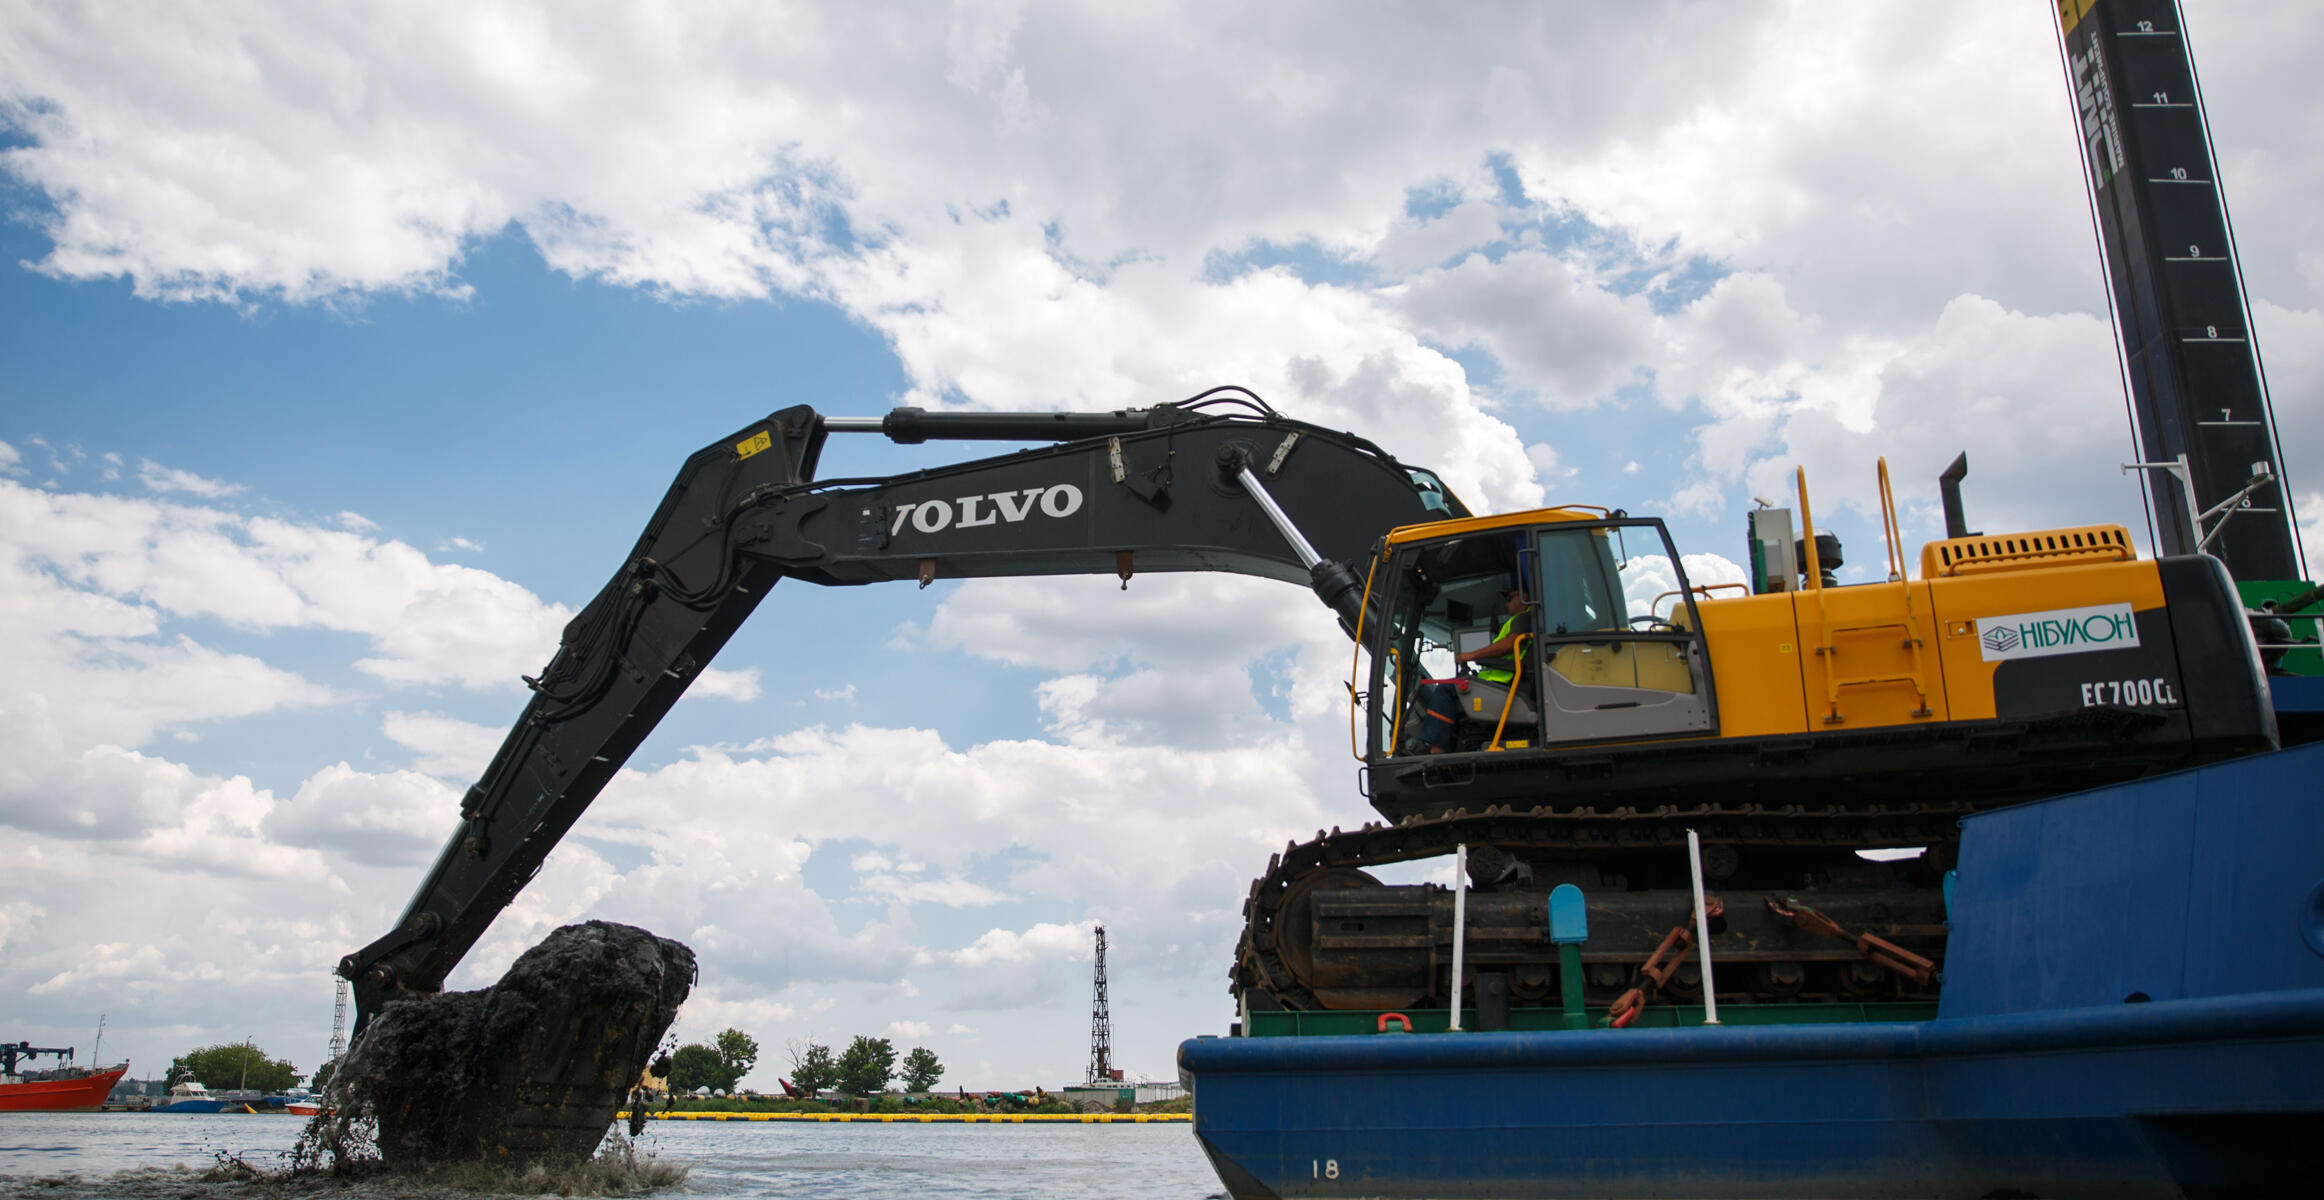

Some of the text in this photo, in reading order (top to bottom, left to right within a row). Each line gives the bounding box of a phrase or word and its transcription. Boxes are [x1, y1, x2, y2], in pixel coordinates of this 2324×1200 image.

[2137, 20, 2153, 32] 12
[2090, 31, 2125, 168] MARINE EQUIPMENT
[2153, 92, 2168, 104] 11
[2071, 47, 2118, 190] DMT
[2170, 168, 2187, 180] 10
[2189, 245, 2200, 257] 9
[2207, 326, 2218, 338] 8
[2221, 408, 2231, 421] 7
[2019, 612, 2134, 649] НІБУЛОН
[1313, 1159, 1339, 1180] 18
